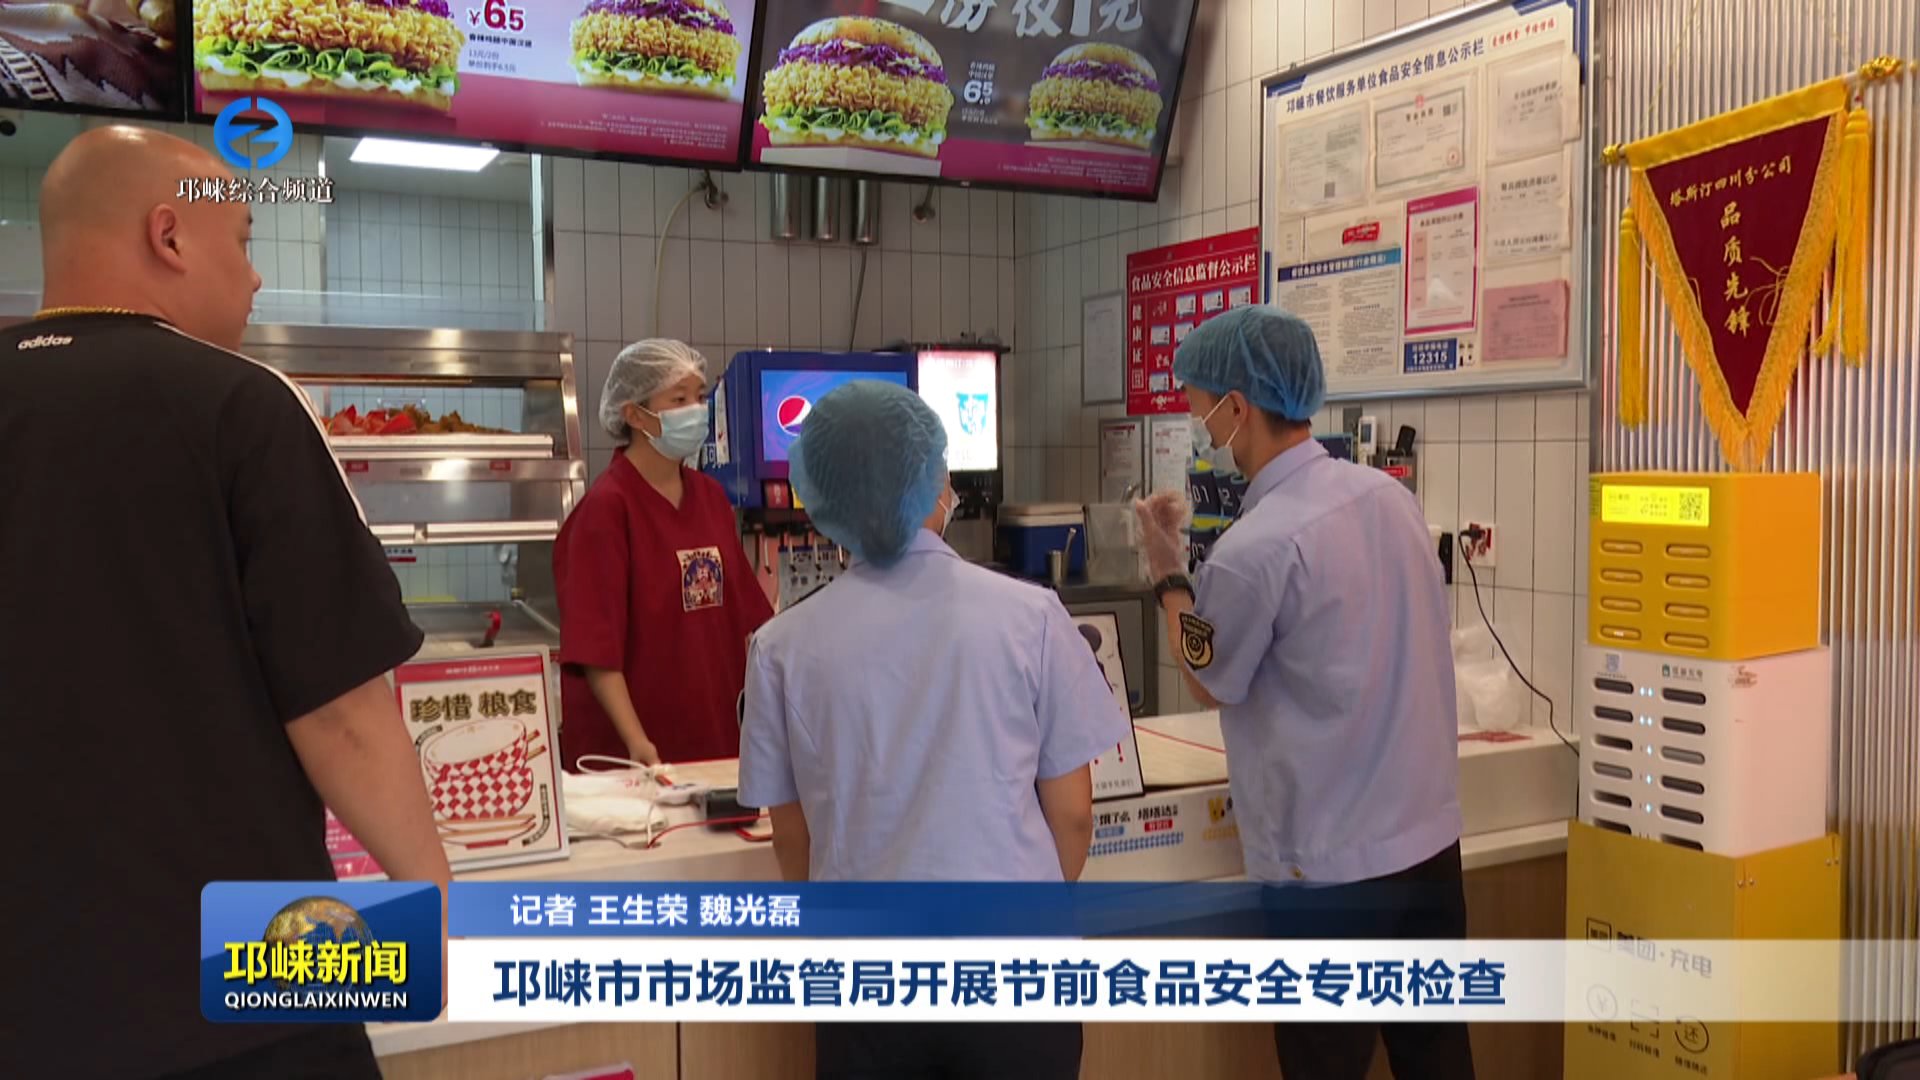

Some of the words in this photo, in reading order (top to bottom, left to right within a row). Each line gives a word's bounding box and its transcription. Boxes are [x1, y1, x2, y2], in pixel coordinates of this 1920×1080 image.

[1286, 37, 1485, 113] 邛崃市餐饮服务单位食品安全信息公示栏
[1131, 252, 1257, 293] 食品安全信息监督公示栏
[1720, 200, 1751, 338] 品质先锋
[18, 334, 73, 350] adidas
[1413, 351, 1448, 366] 12315
[410, 695, 472, 723] 珍惜
[478, 688, 537, 716] 粮食
